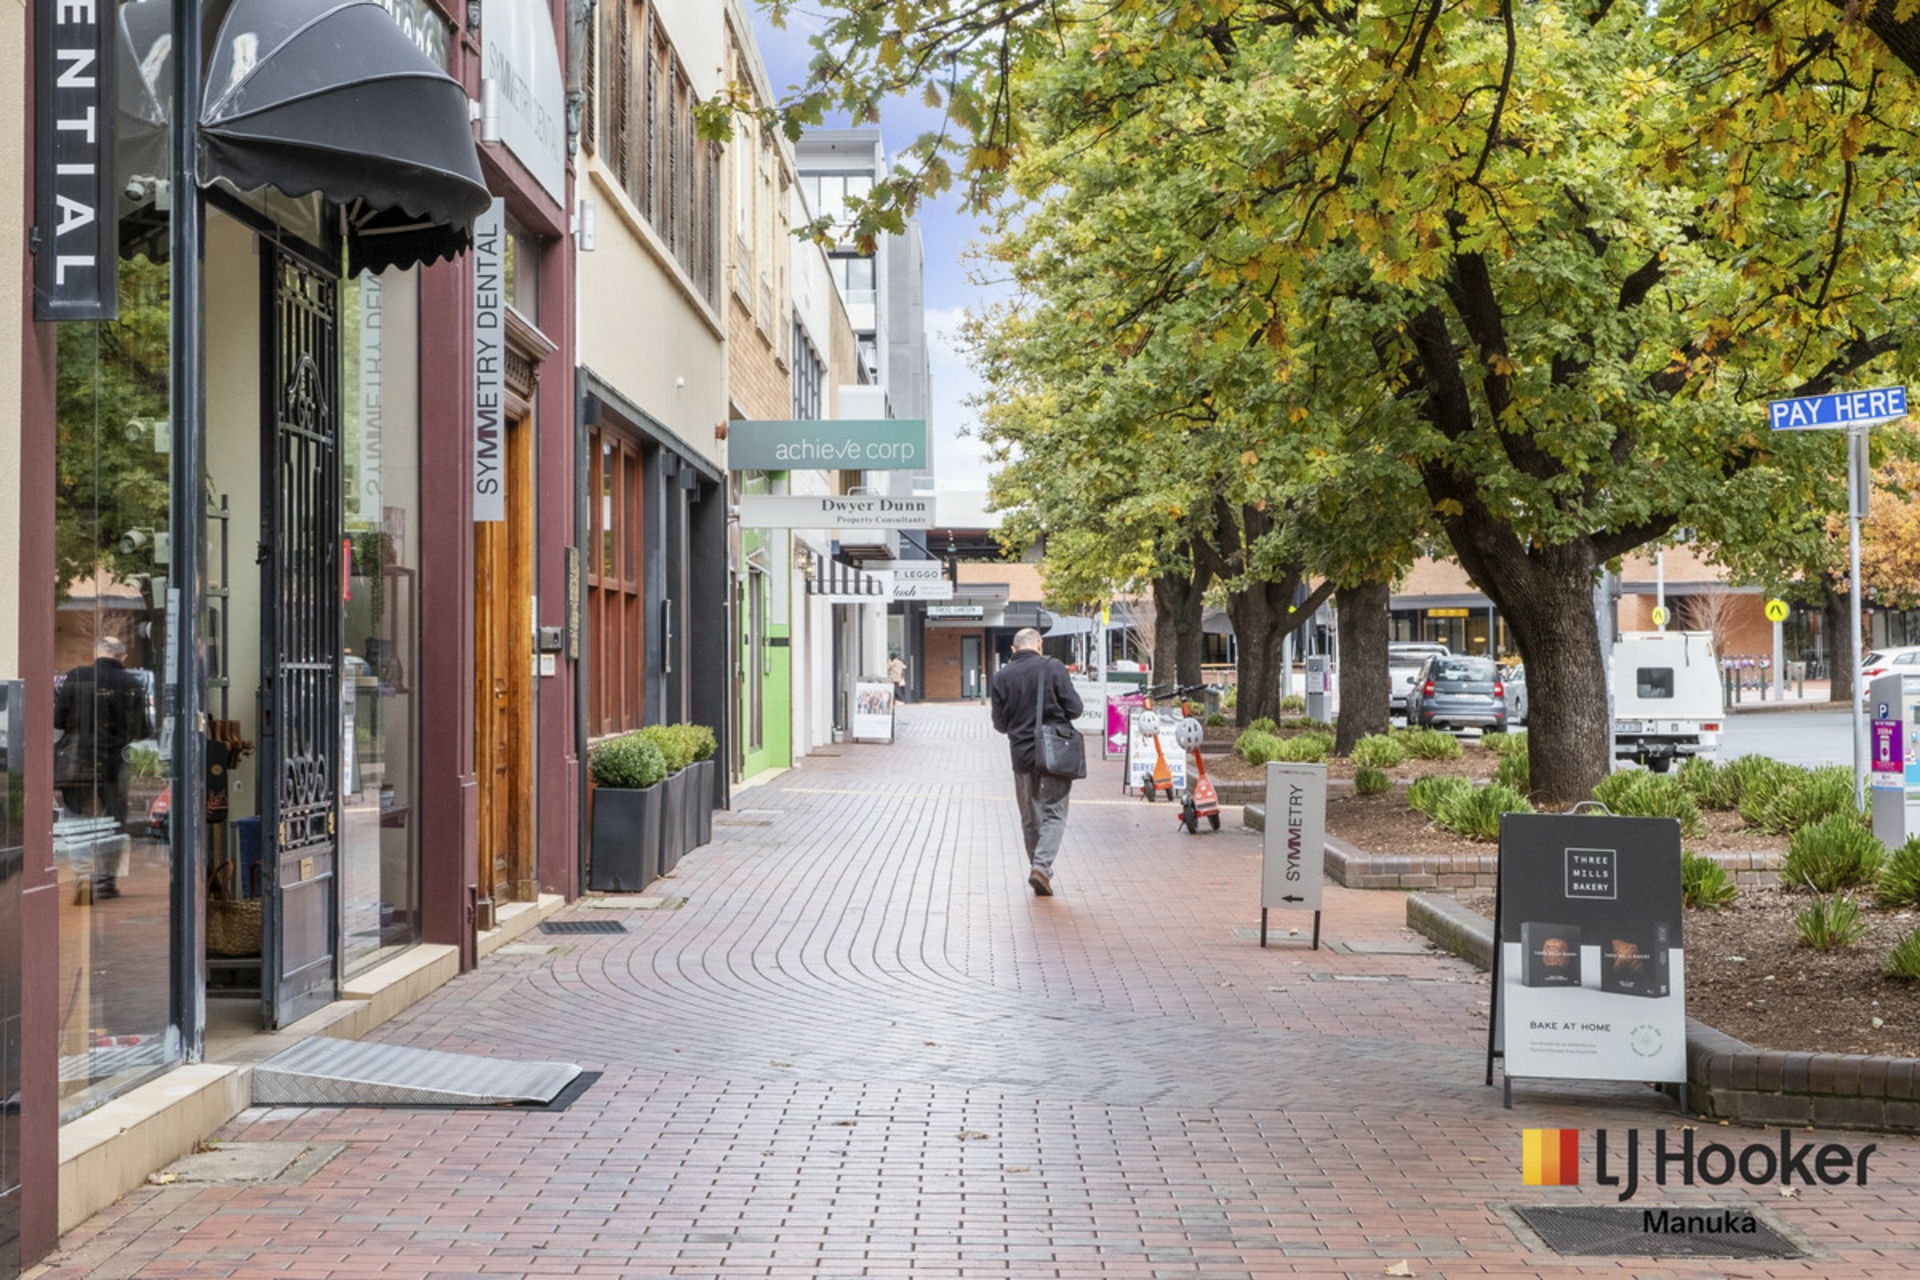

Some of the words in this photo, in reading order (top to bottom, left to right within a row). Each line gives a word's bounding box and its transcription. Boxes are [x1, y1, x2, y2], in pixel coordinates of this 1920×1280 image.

[56, 0, 95, 285] ENTIAL
[475, 222, 499, 330] DENTAL
[1773, 399, 1822, 428] PAY
[1835, 389, 1903, 420] HERE
[475, 338, 499, 495] SYMMETRY
[775, 438, 861, 460] achieve
[866, 441, 915, 463] corp
[822, 499, 874, 514] Dwyer
[880, 499, 926, 511] Dunn
[836, 515, 873, 525] Property
[875, 515, 926, 524] Consultants
[904, 570, 939, 578] LEGGO
[1286, 784, 1304, 882] SYMMETRY
[1573, 855, 1608, 865] THREE
[1573, 869, 1609, 878] MILLS
[1573, 882, 1609, 891] BAKERY
[1529, 1021, 1558, 1030] BAKE
[1580, 1023, 1611, 1032] HOME
